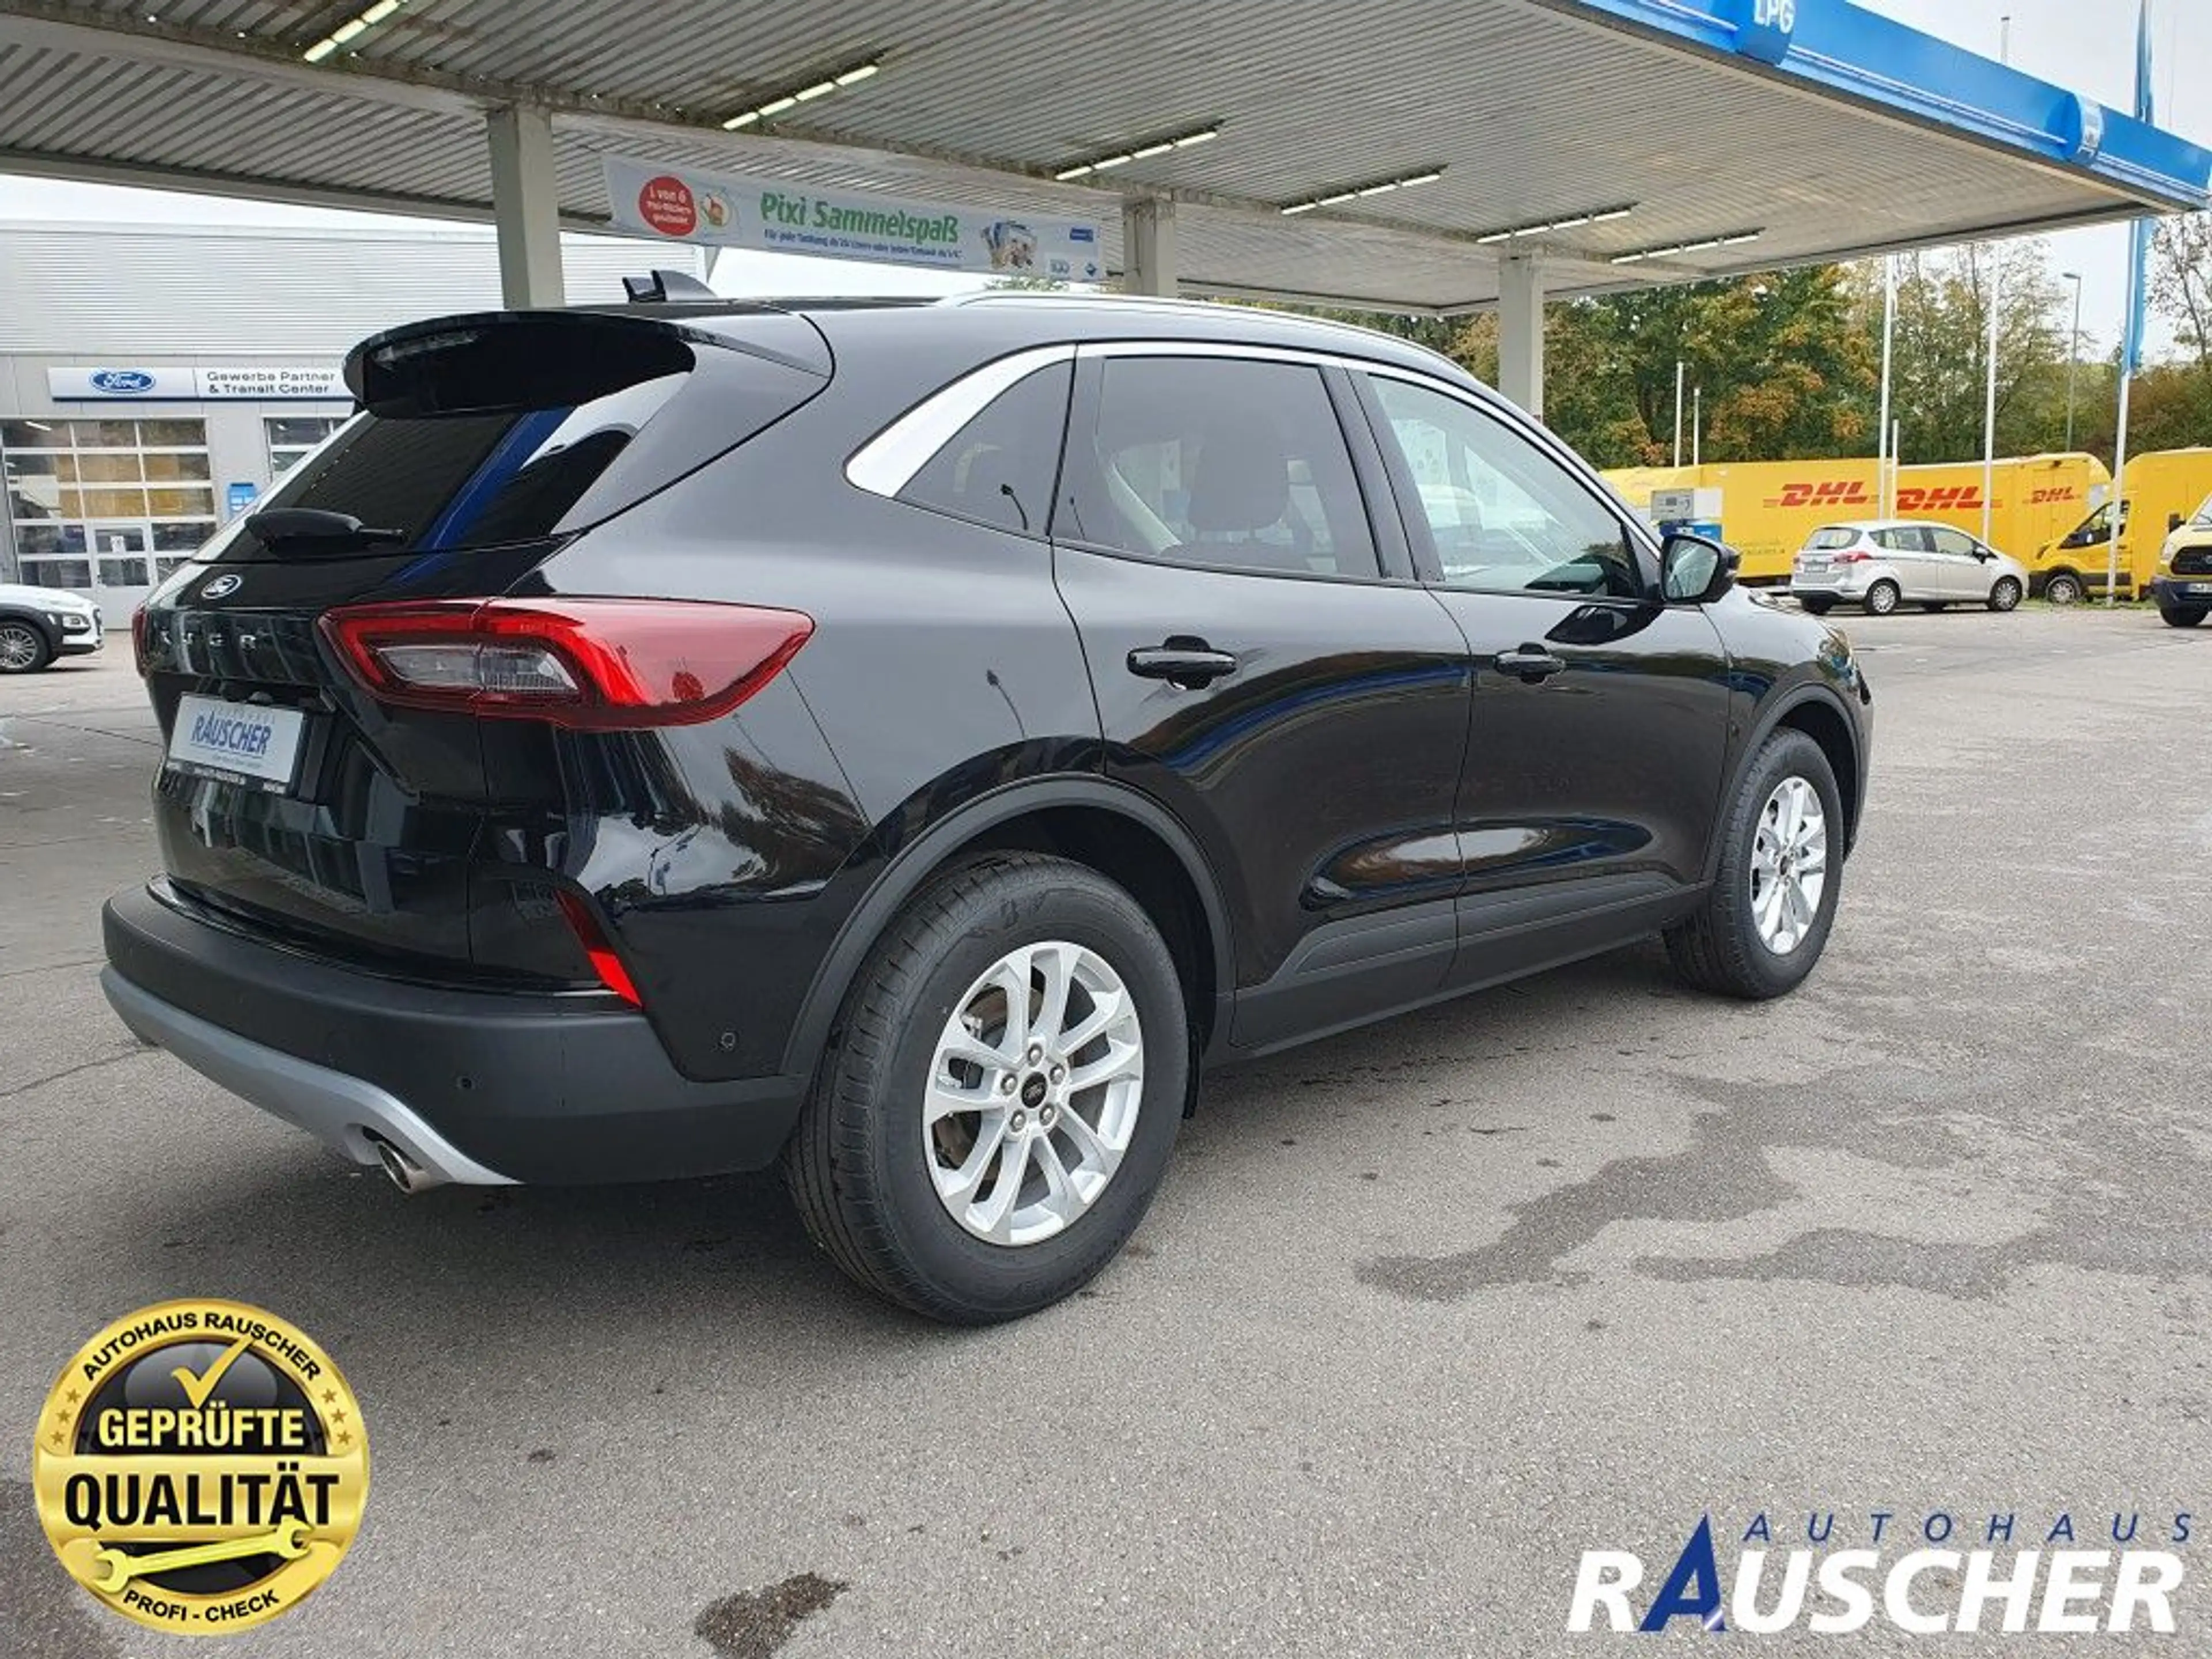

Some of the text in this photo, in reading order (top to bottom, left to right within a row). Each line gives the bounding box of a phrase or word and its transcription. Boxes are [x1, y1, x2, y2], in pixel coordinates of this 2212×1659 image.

[1754, 0, 1795, 33] LPG
[760, 191, 959, 245] Pixi Sammelspaß
[103, 372, 141, 389] Ford
[207, 372, 335, 381] Gewerbe Partner
[209, 384, 329, 394] & Transit Center
[1781, 482, 1868, 506] DHL
[1896, 486, 1984, 511] DHL
[2031, 486, 2075, 504] DHL
[191, 711, 271, 755] RAUSCHER
